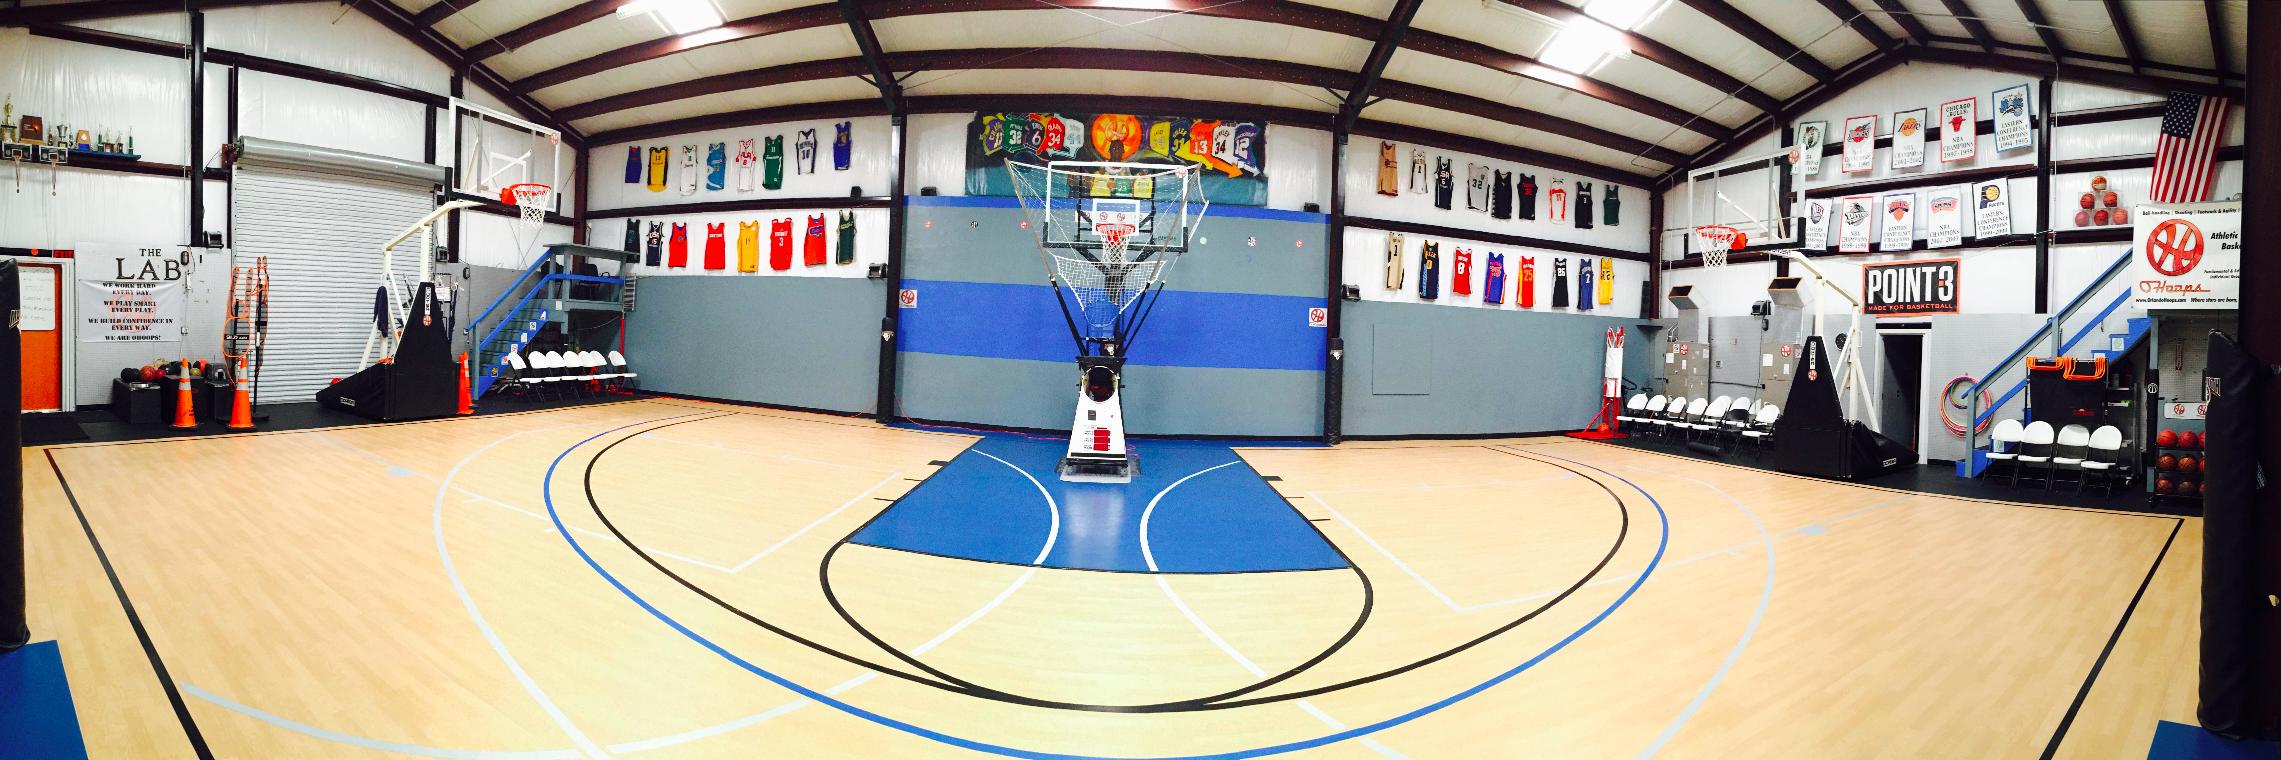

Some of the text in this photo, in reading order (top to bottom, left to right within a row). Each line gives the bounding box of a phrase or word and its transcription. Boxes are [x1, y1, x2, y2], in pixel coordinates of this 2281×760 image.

[1946, 103, 1971, 112] CHICAGO
[1048, 132, 1060, 146] 34
[1194, 140, 1208, 154] 13
[1214, 140, 1226, 156] 34
[1943, 142, 1974, 152] CHAMPIONS
[1472, 178, 1482, 190] 32
[2210, 231, 2238, 240] Athletic
[779, 238, 784, 246] 3
[139, 248, 162, 256] THE
[1394, 244, 1398, 256] 1
[115, 258, 182, 280] LAB
[1524, 270, 1533, 282] 25
